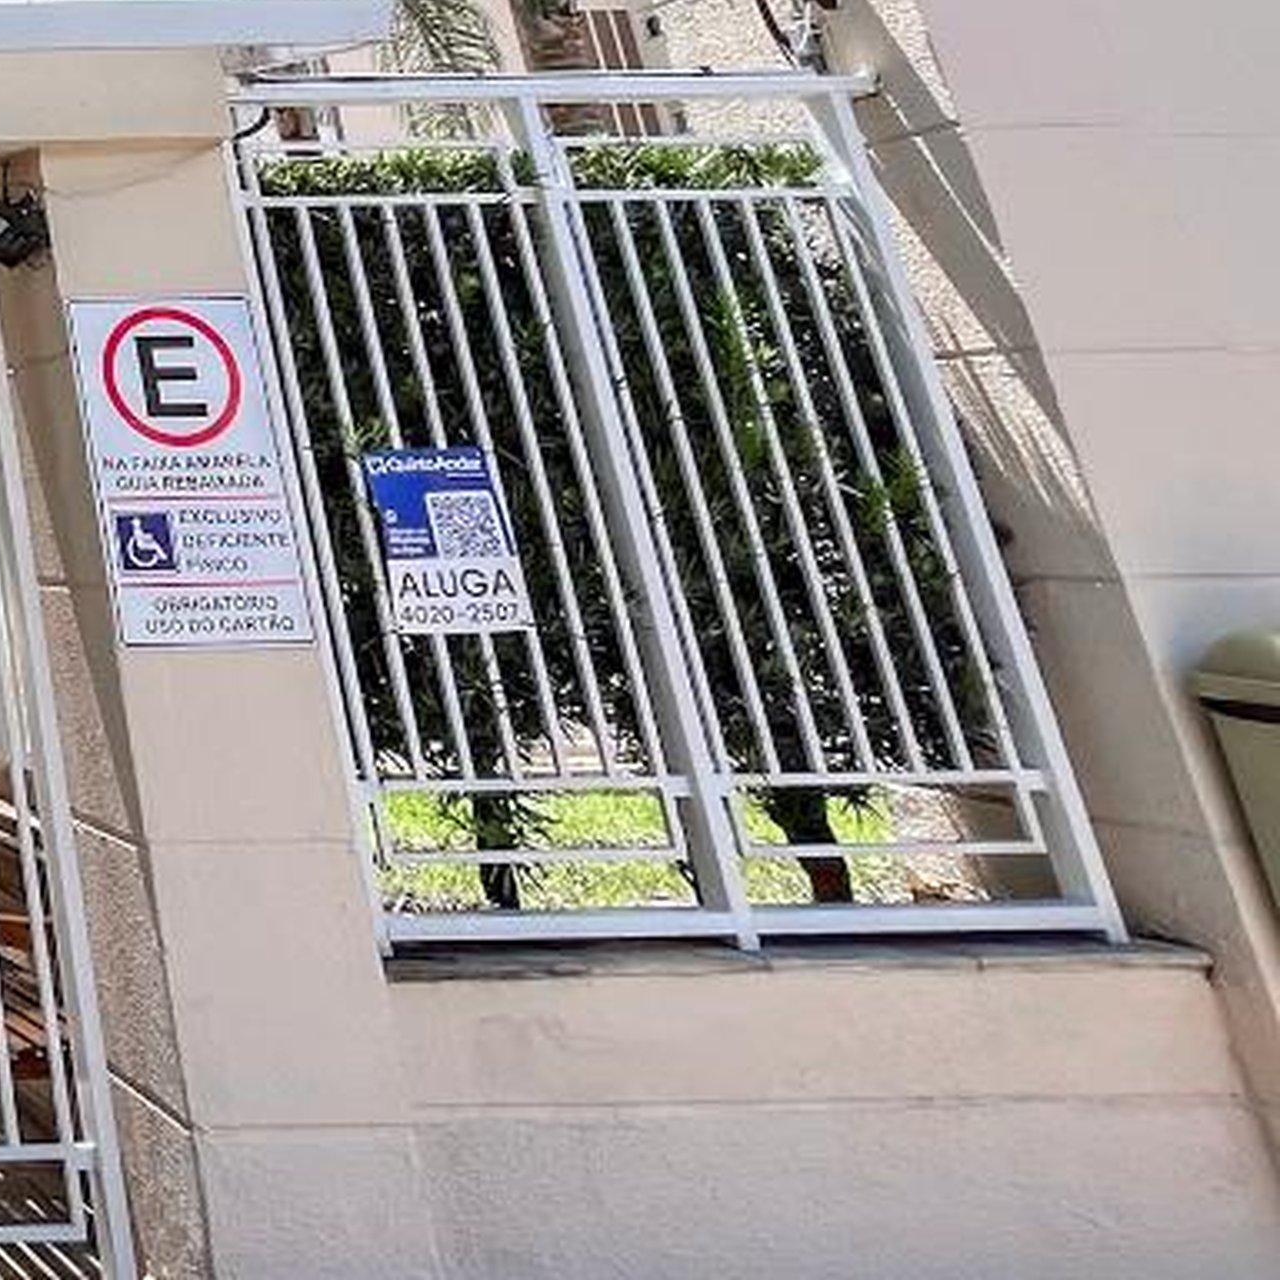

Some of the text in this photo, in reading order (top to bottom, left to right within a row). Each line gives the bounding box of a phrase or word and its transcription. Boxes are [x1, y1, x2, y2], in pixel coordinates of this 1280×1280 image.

[133, 335, 209, 418] E
[180, 509, 281, 524] EXCLUSIVO
[183, 532, 290, 548] DEFICIENTE
[398, 568, 517, 599] ALUGA
[145, 614, 295, 634] USO DO CARTÃO
